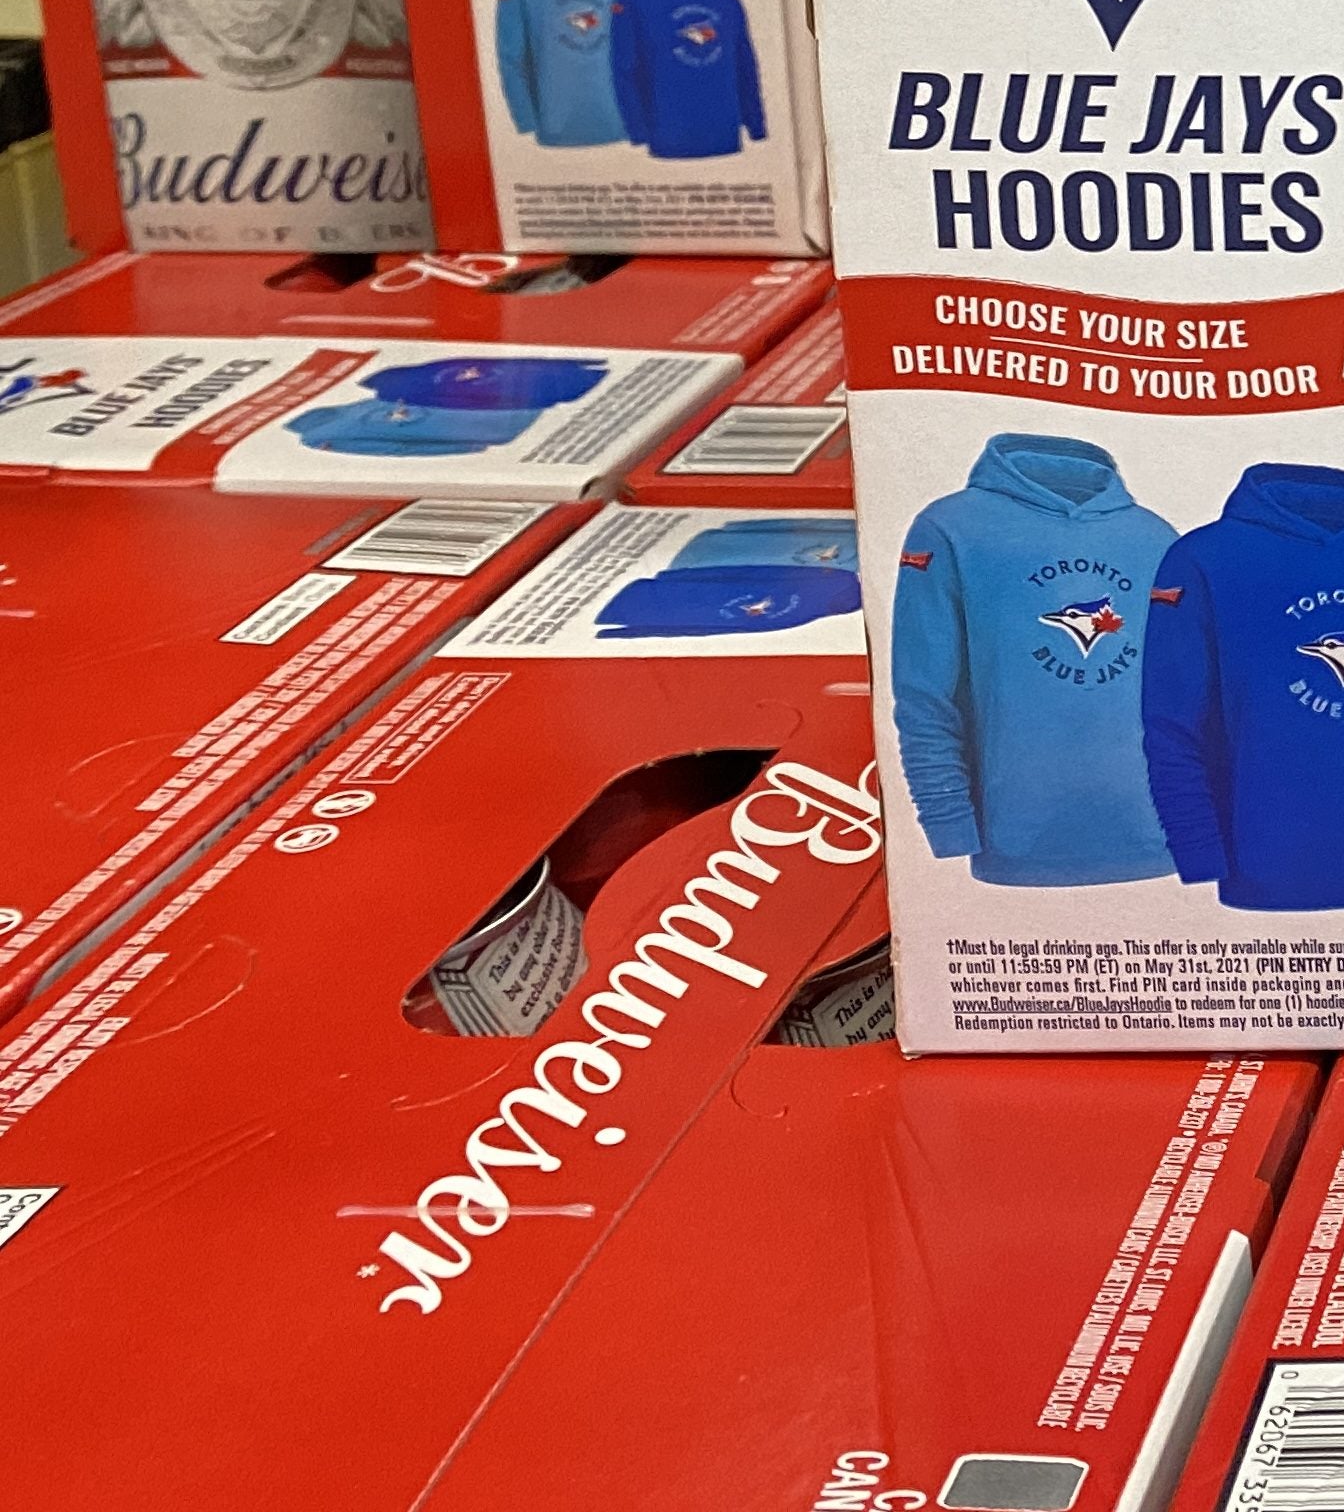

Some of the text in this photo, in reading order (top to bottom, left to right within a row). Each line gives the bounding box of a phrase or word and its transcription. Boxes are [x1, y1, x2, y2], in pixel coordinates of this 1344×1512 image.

[888, 71, 1117, 153] BLUE
[932, 168, 1324, 253] HOODIES
[934, 294, 1248, 350] CHOOSE YOUR SIZE
[892, 345, 1319, 401] DELIVERED TO YOUR DOOR
[1028, 557, 1133, 593] TORONTO
[1031, 643, 1138, 685] BLUE JAYS
[1289, 680, 1342, 719] BLUE
[990, 940, 1006, 955] be
[1009, 940, 1039, 958] legal
[1043, 940, 1092, 958] drinking
[1096, 943, 1122, 958] age.
[1123, 940, 1150, 955] This
[1154, 940, 1184, 955] offer
[1187, 940, 1198, 954] is
[1201, 940, 1228, 957] only
[1231, 940, 1287, 954] available
[1289, 940, 1326, 954] while
[380, 762, 882, 1313] Budweiser
[1255, 1405, 1292, 1468] 62067
